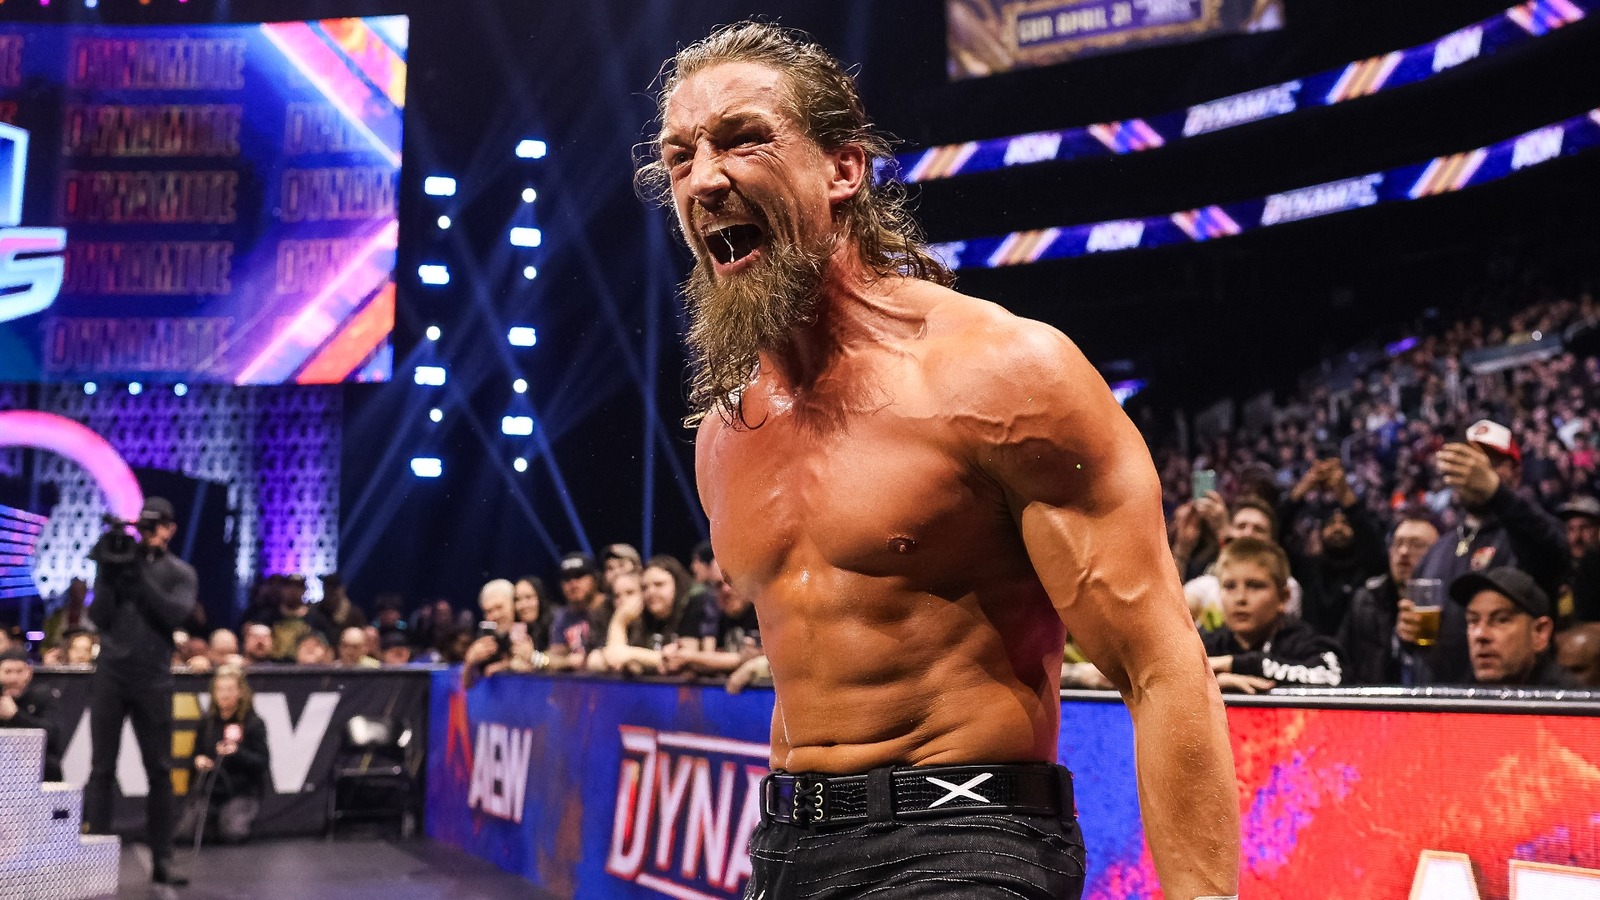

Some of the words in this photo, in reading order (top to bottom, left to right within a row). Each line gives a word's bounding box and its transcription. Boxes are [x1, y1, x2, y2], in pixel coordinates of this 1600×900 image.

[1055, 6, 1107, 35] APRIL
[1182, 79, 1302, 137] DYNAMITE
[1260, 171, 1384, 226] DYNAMITE
[467, 721, 533, 824] AEW
